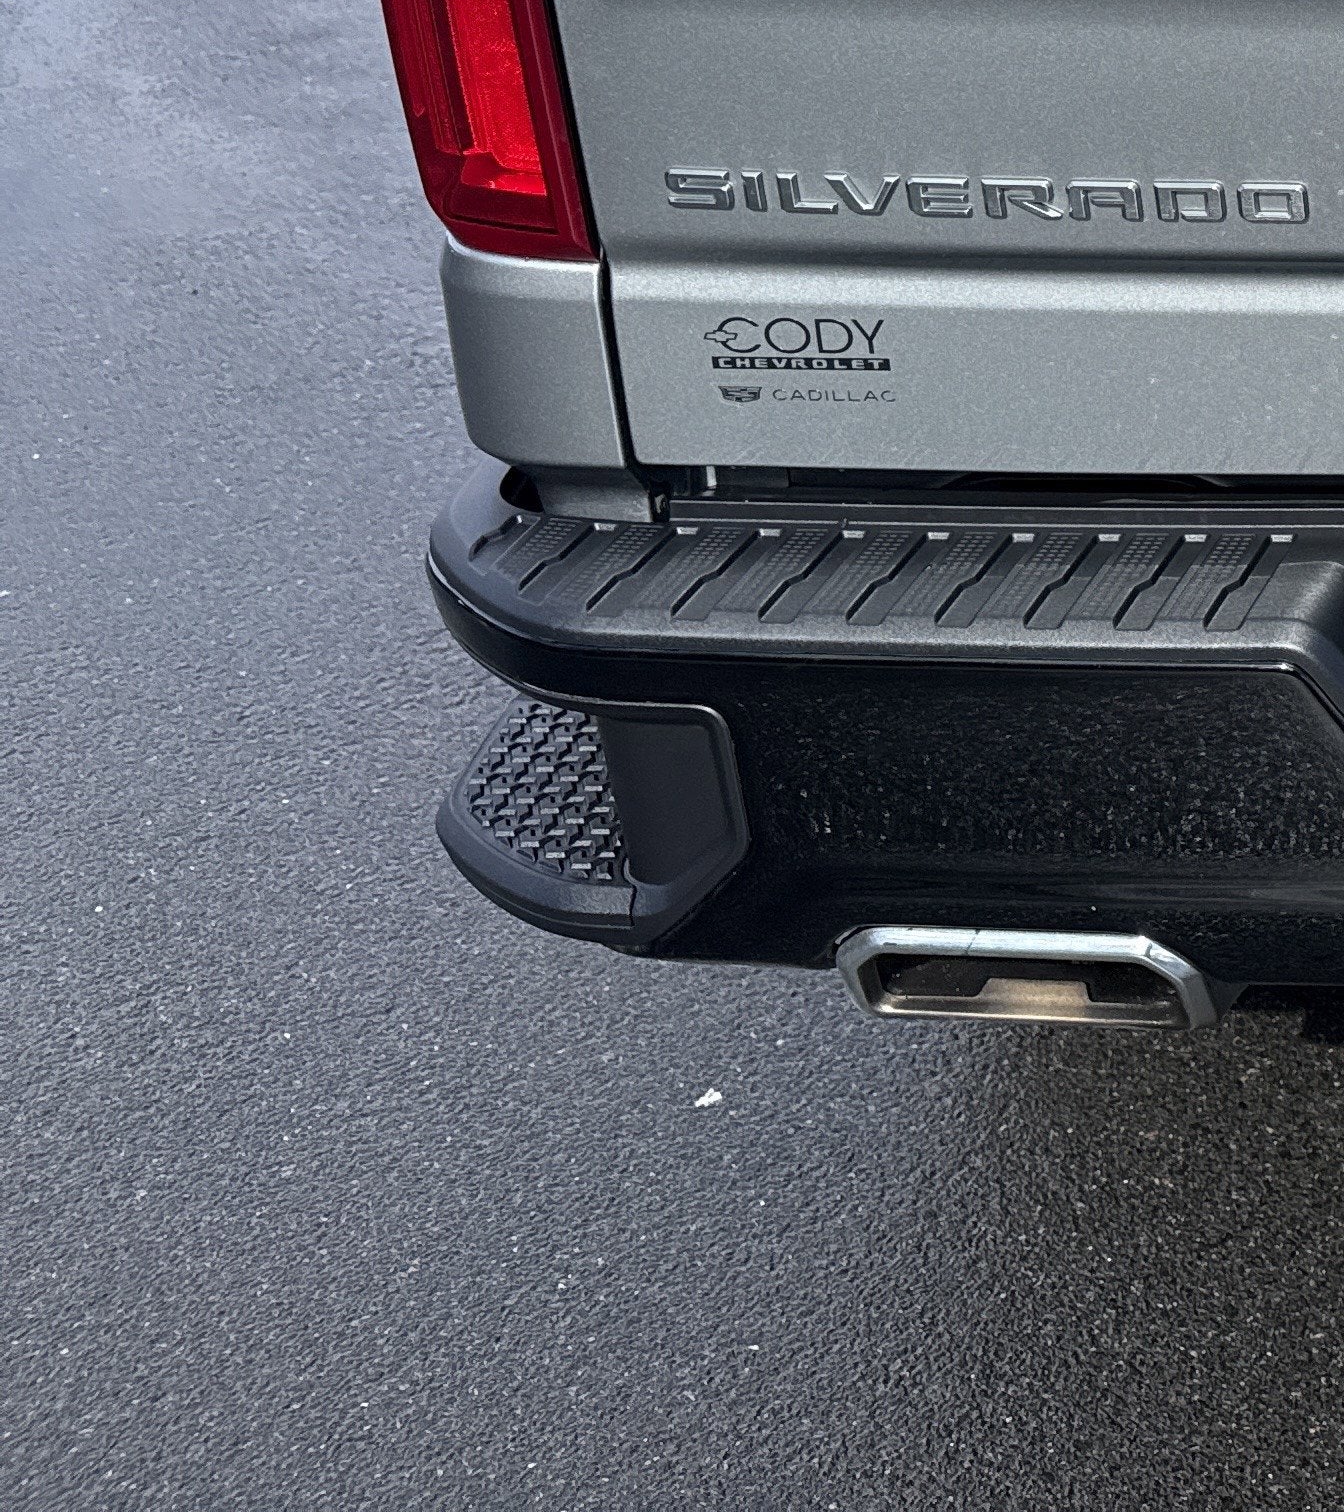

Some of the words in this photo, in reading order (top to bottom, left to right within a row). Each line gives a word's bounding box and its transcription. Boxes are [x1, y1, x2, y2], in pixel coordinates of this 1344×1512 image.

[664, 166, 1310, 224] SILVERADO
[705, 316, 885, 355] CODY
[717, 356, 885, 370] CHEVROLET
[771, 388, 897, 403] CADILLAC
